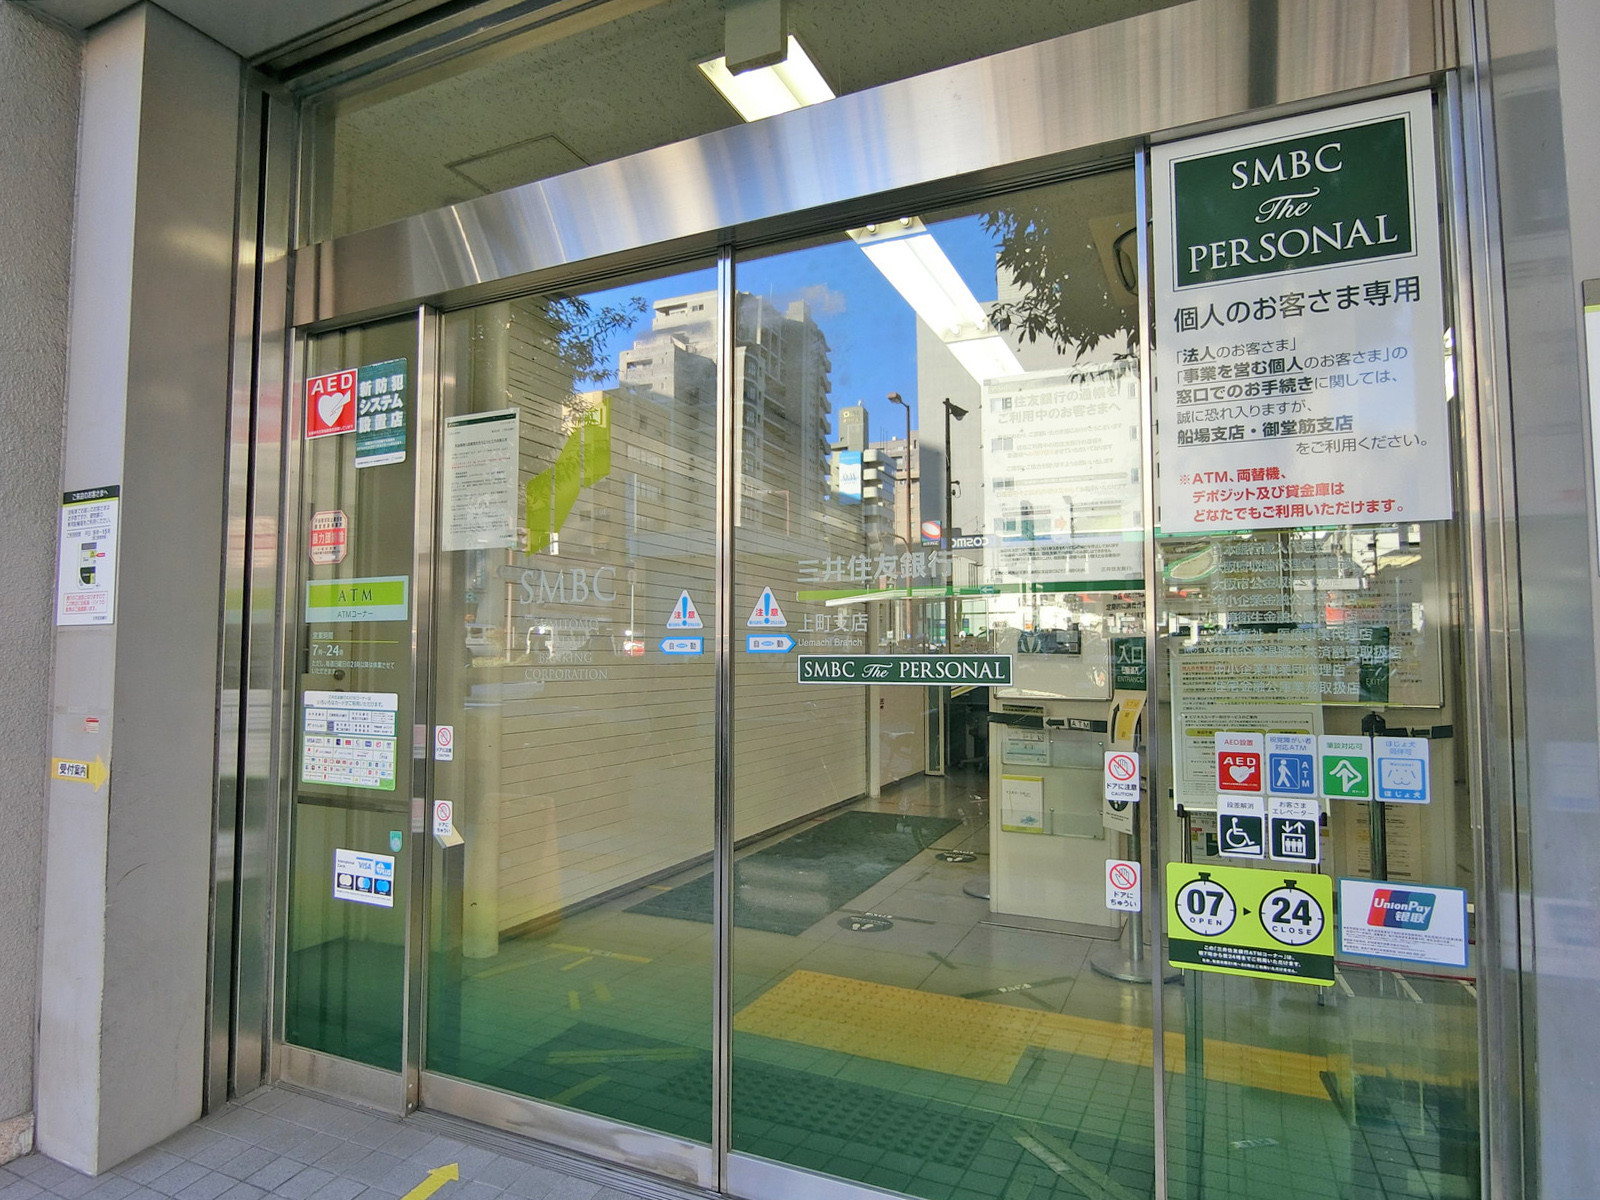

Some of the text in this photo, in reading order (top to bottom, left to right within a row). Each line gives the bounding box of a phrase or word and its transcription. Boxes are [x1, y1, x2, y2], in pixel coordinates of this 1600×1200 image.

[1231, 143, 1343, 190] SMBC
[1255, 187, 1320, 223] The
[1188, 214, 1398, 274] PERSONAL
[1174, 276, 1420, 333] 個人のお客さま専用
[1176, 337, 1297, 364] 「法人のお客さま」
[1176, 346, 1408, 384] 「事業を営む個人のお客さま」の
[311, 373, 353, 396] AED
[360, 374, 404, 398] 新防犯
[1176, 370, 1399, 404] 窓口でのお手続きに関しては、
[360, 393, 404, 415] システム
[998, 402, 1121, 424] ご利用中のお客さまへ
[1177, 400, 1312, 425] 誠に恐れ入りますが、
[1177, 415, 1353, 444] 船場支店・御堂筋支店
[1296, 434, 1428, 455] をご利用ください。
[1193, 482, 1345, 504] デポジット及び貸金庫は
[1193, 499, 1404, 523] どなたでもご利用いただけます。
[797, 550, 952, 583] 三井住友銀行
[338, 589, 373, 602] ATM
[520, 567, 617, 605] SMBC
[337, 610, 374, 619] ATMコーナー
[797, 614, 868, 633] 上町支店
[798, 638, 863, 648] Uemachi Branch
[1117, 643, 1144, 664] 入口
[525, 668, 608, 680] CORPORATION
[804, 661, 1006, 679] SMBC The PERSONAL
[1365, 678, 1381, 686] EXIT
[1071, 719, 1091, 729] ATM
[1386, 740, 1416, 748] ほじょ犬
[59, 763, 86, 776] 受付案内
[1223, 756, 1256, 766] AED
[1301, 761, 1309, 788] ATM
[1106, 782, 1137, 791] ドアに注意
[1384, 790, 1421, 799] ほじょ犬
[1226, 801, 1254, 809] 段差解消
[1272, 808, 1315, 817] エレベーター
[1279, 801, 1307, 809] お客さま
[1110, 898, 1136, 908] ちゅうい
[1113, 890, 1133, 899] ドアに
[1186, 889, 1224, 916] 07
[1271, 896, 1312, 927] 24
[1374, 898, 1431, 915] UnionPay
[1190, 916, 1224, 926] OPEN
[1271, 925, 1313, 936] CLOSE
